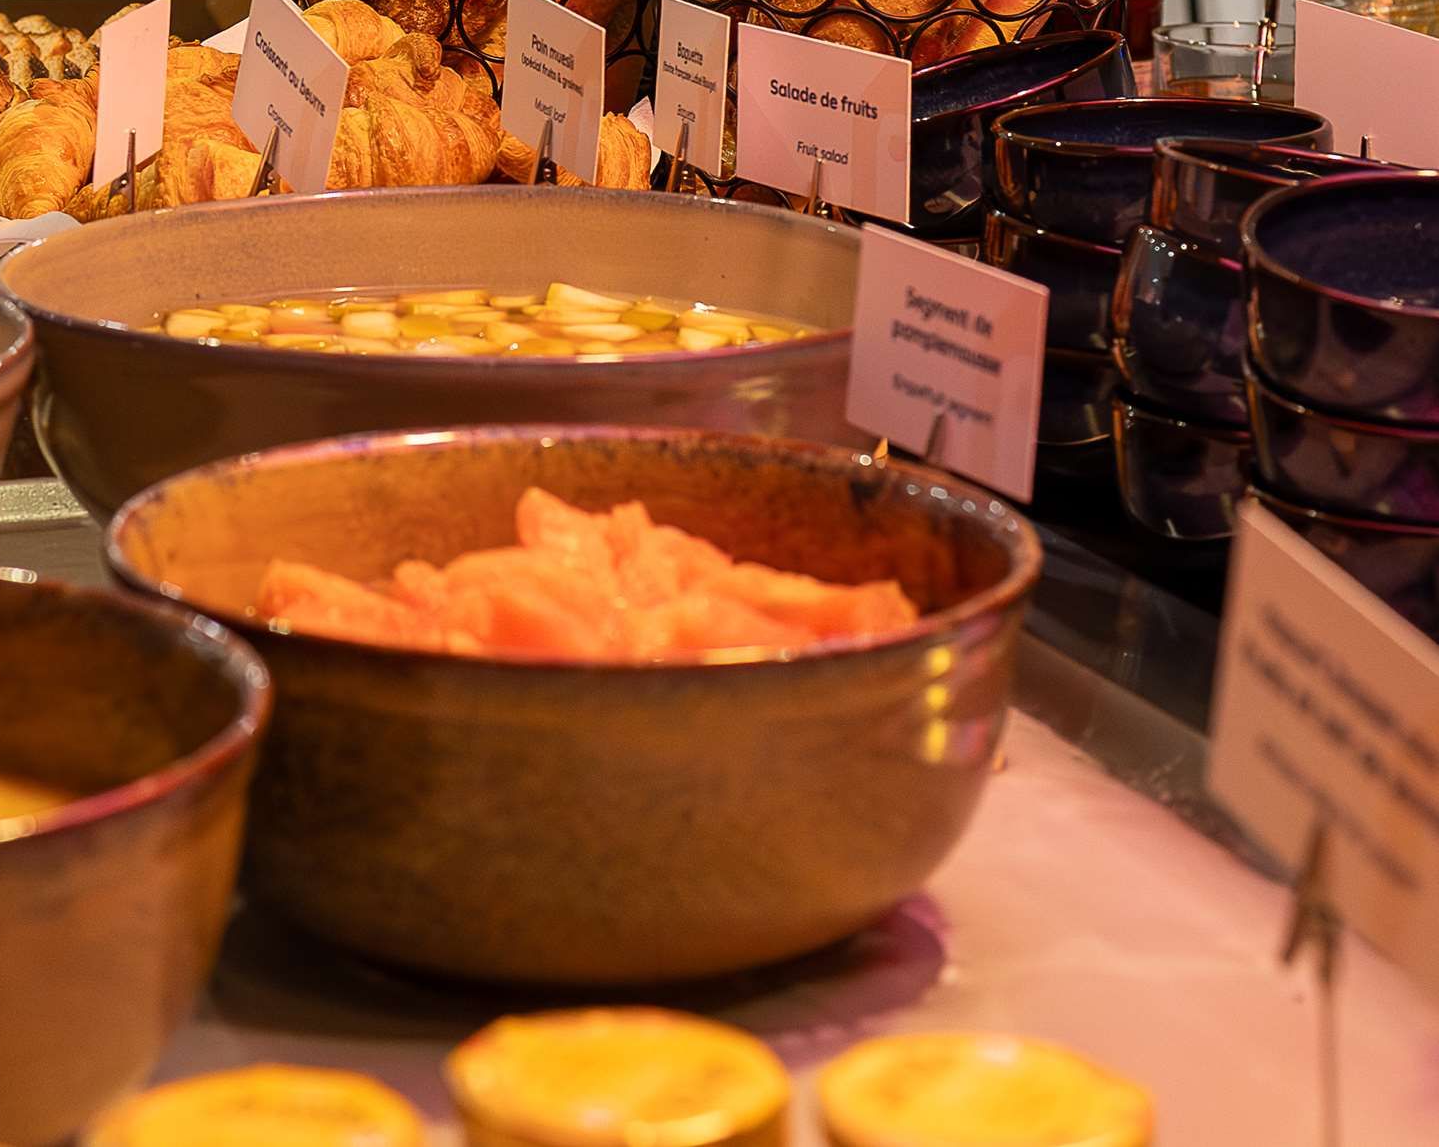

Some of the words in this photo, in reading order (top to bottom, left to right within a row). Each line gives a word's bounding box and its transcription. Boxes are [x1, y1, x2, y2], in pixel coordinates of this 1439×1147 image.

[531, 34, 548, 56] Pain
[549, 46, 575, 71] muesli
[255, 30, 288, 77] Croissant
[288, 70, 300, 88] au
[299, 77, 326, 117] beurre
[770, 79, 817, 105] Salade
[820, 91, 838, 110] de
[841, 95, 878, 119] fruits
[797, 141, 819, 158] Fruit
[820, 149, 848, 165] salad
